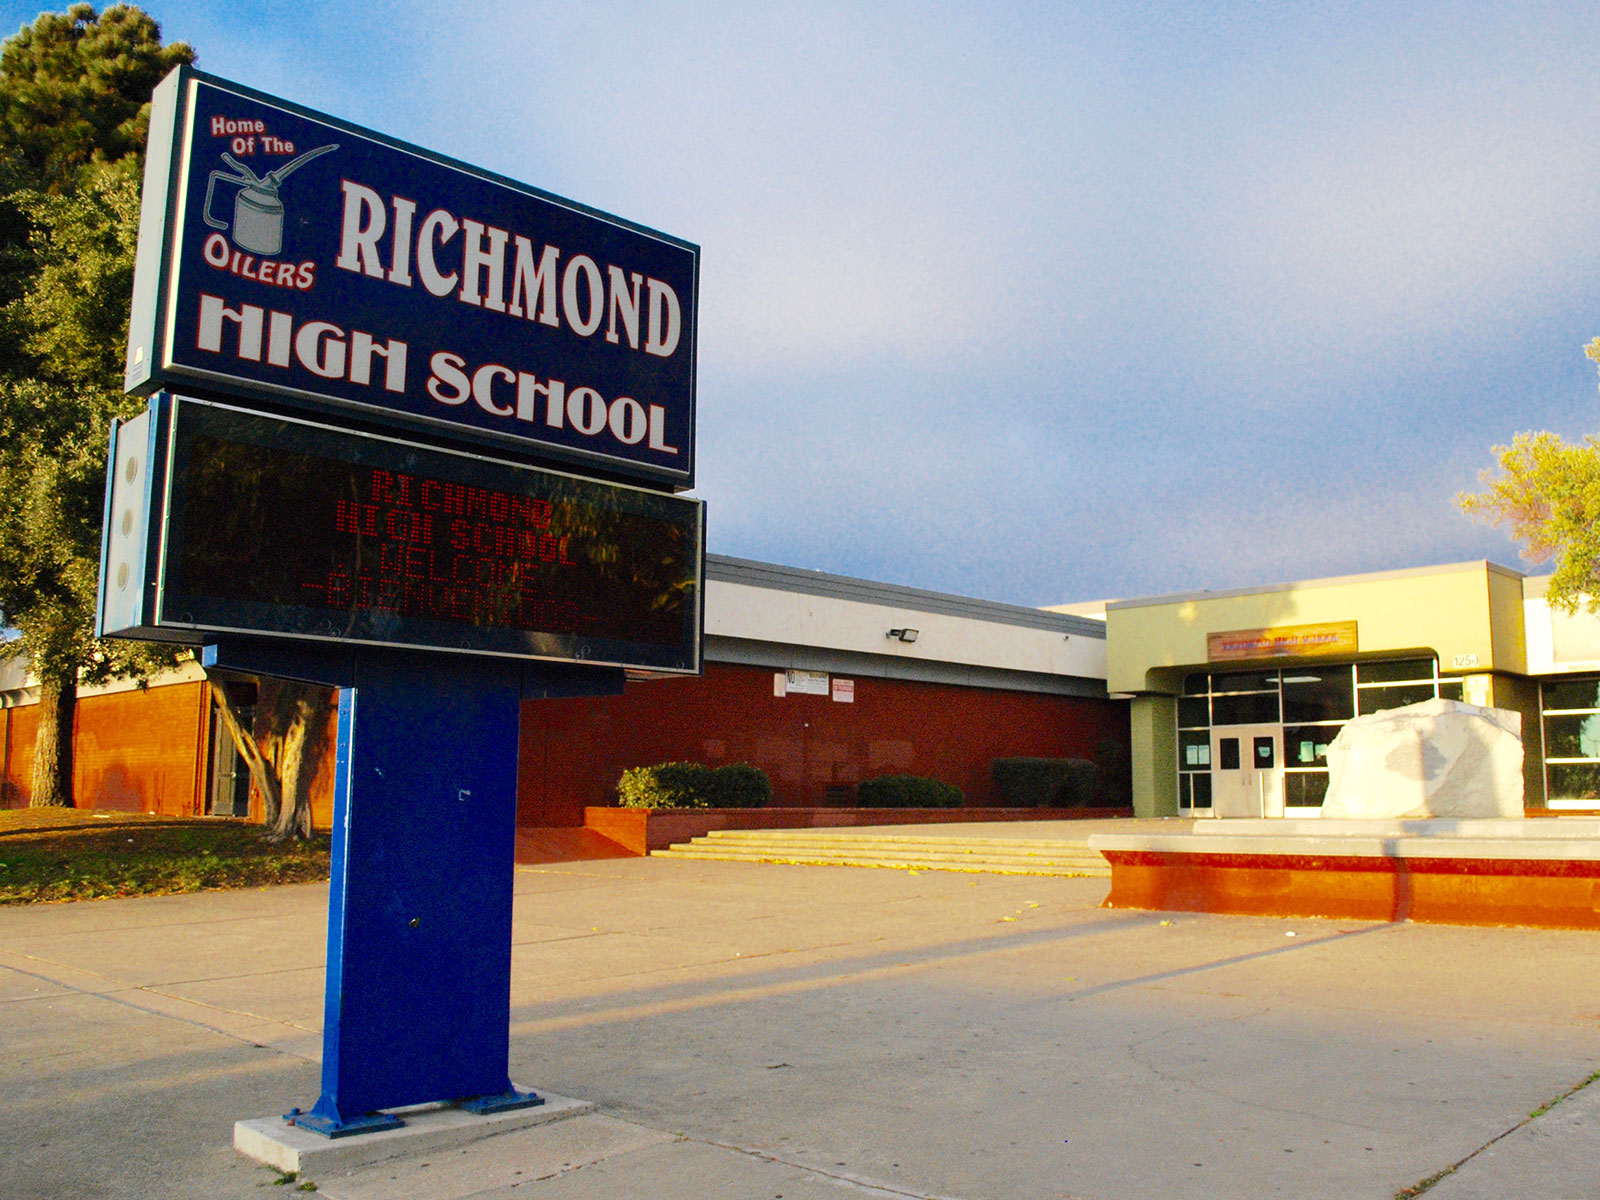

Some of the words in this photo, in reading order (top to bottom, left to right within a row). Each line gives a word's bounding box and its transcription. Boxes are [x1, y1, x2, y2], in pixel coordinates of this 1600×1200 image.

[211, 116, 266, 135] Home
[232, 137, 255, 154] Of
[260, 136, 295, 153] The
[204, 233, 316, 290] OILERS
[335, 178, 682, 358] RICHMOND
[196, 292, 408, 394] HIGH
[426, 350, 680, 455] SCHOOL
[371, 469, 553, 530] RICHMOND
[336, 498, 433, 545] HIGH
[449, 518, 577, 567] SCHOOL
[1453, 655, 1479, 667] 1250
